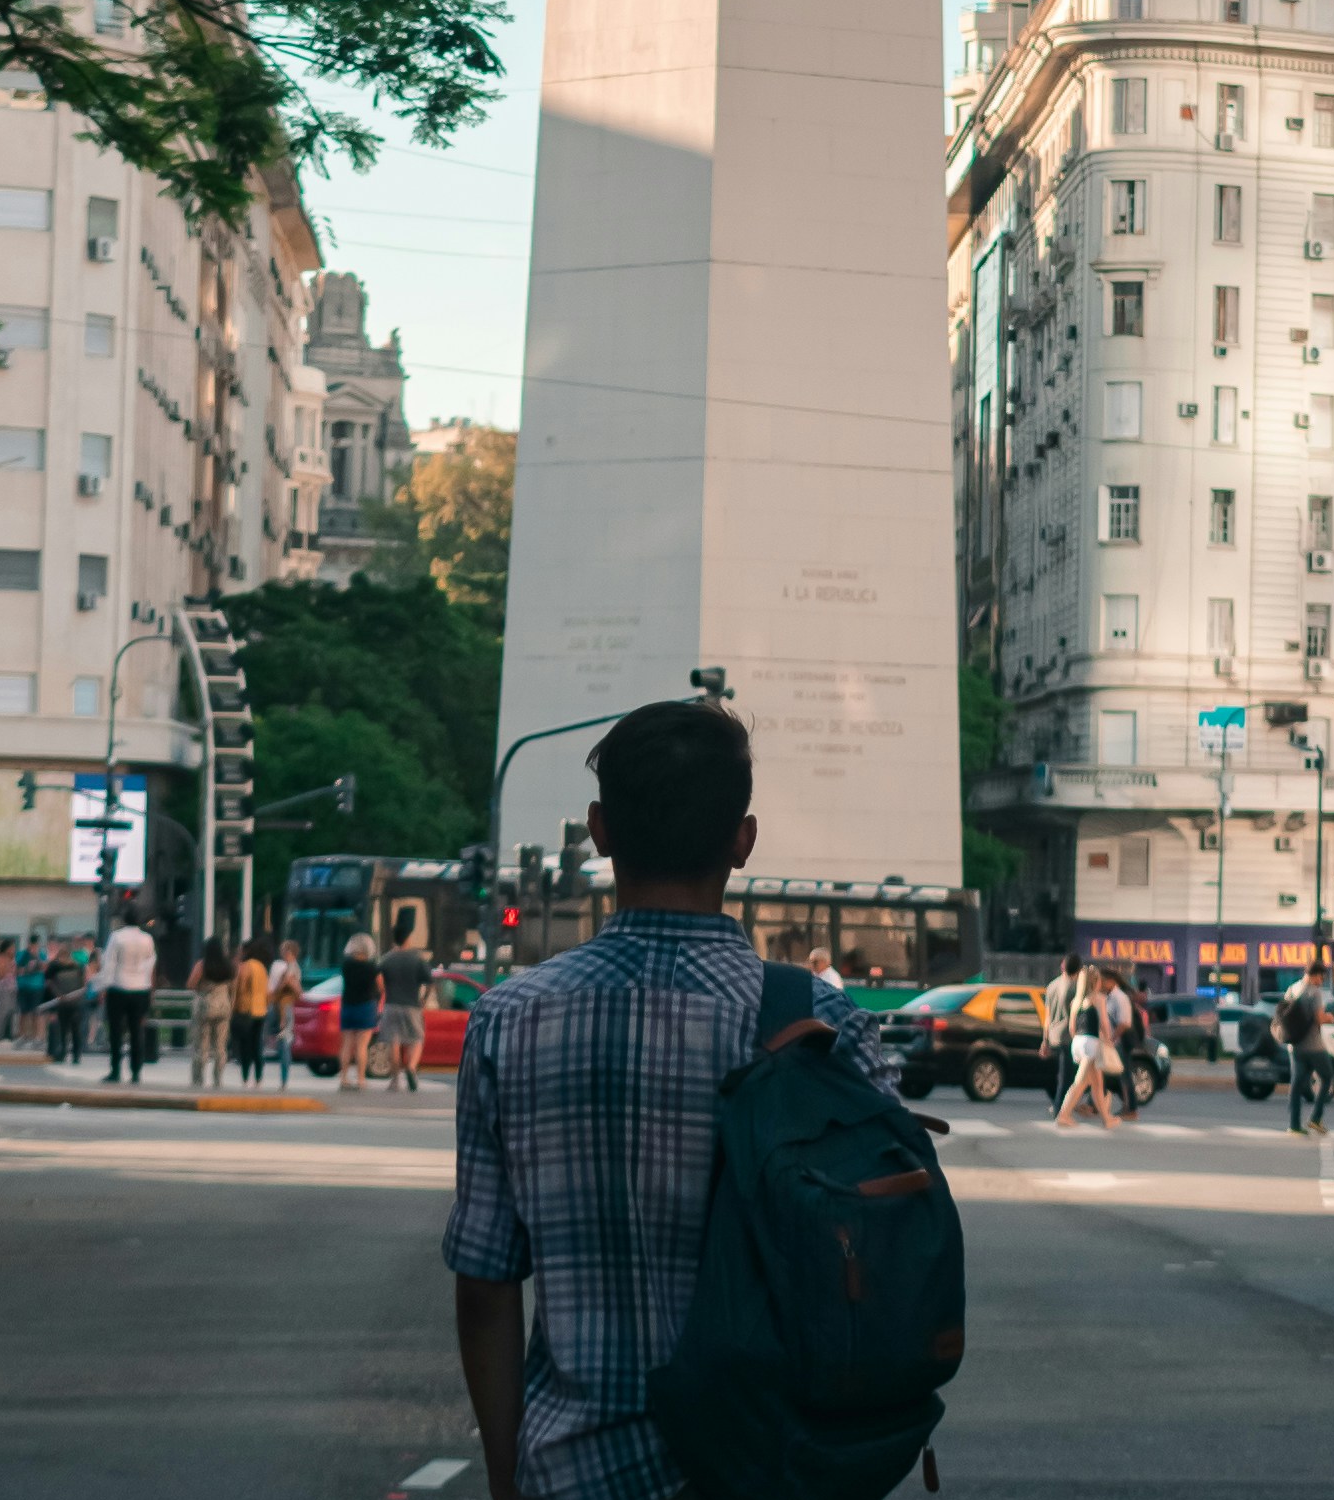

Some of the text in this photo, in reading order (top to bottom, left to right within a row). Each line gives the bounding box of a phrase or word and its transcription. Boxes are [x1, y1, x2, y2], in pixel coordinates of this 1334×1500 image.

[1090, 939, 1114, 960] LA
[1115, 939, 1174, 963] NUEVA
[1258, 942, 1279, 965] LA
